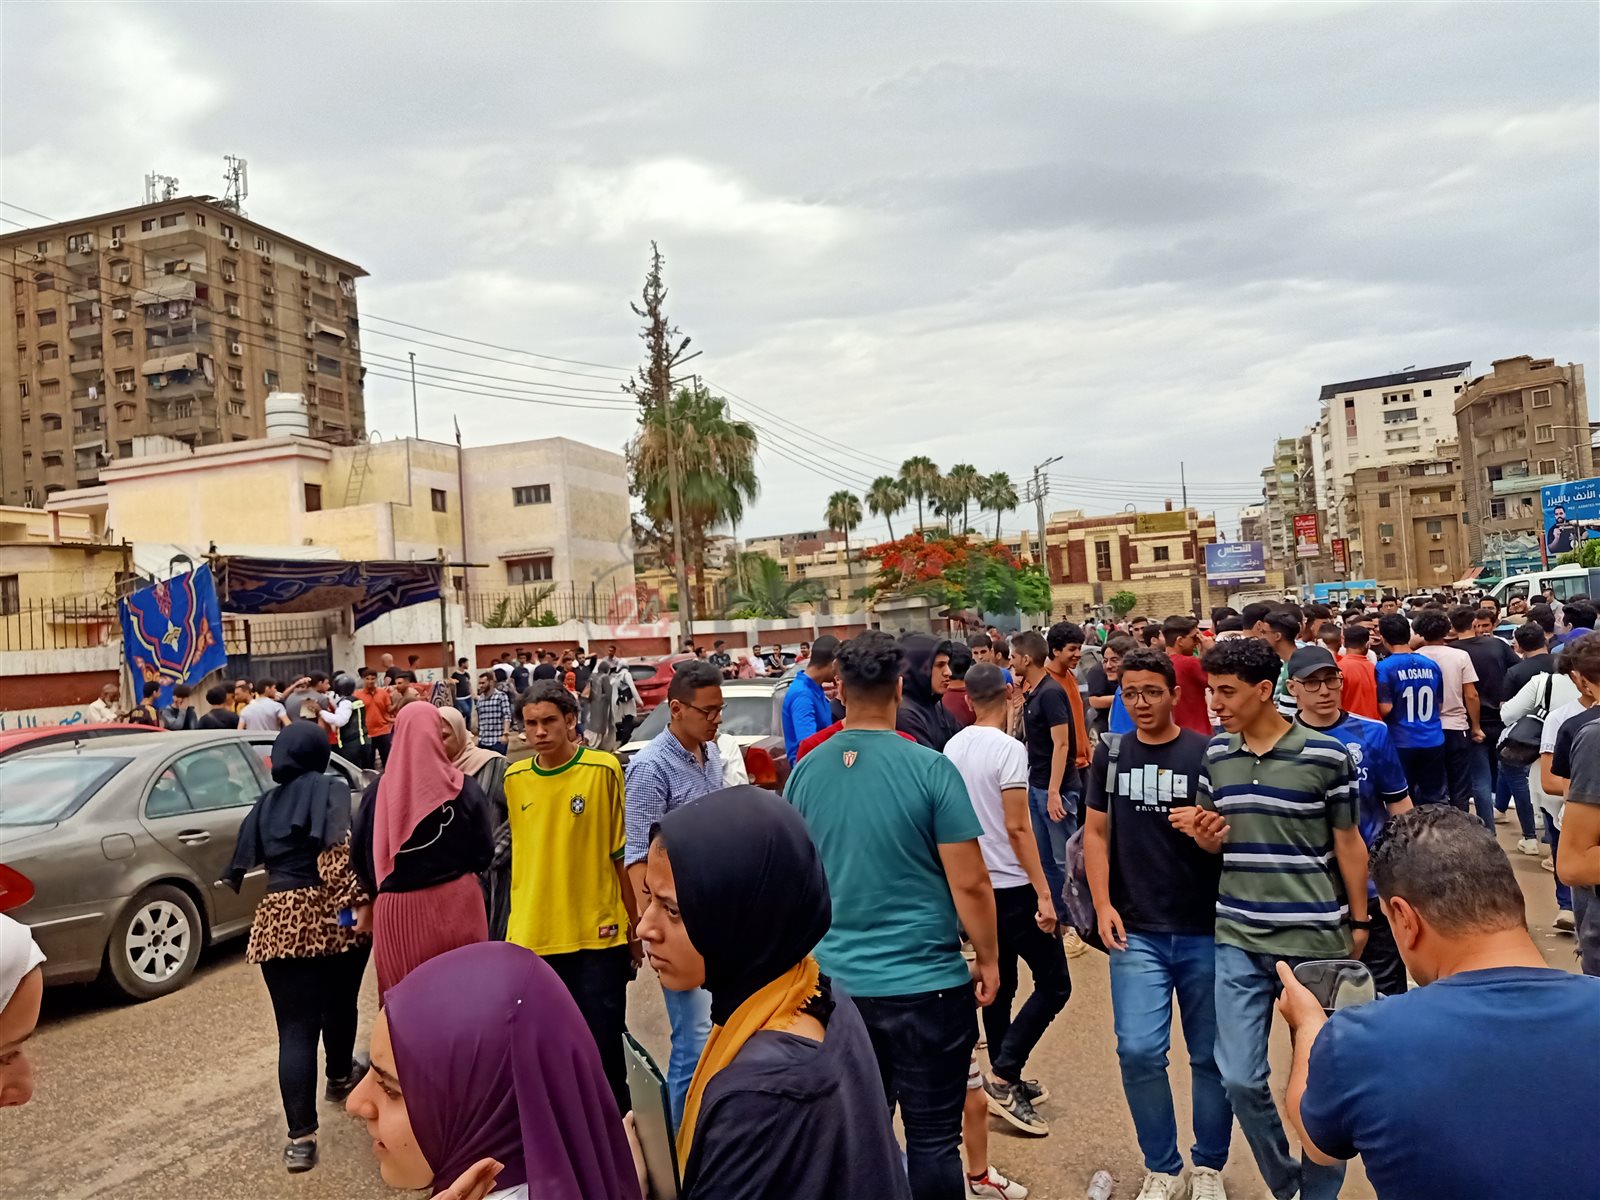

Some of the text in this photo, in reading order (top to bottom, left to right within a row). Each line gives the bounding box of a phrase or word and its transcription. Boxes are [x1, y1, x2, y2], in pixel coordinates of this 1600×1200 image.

[1547, 495, 1571, 507] بالليزر
[1573, 490, 1596, 501] الأنف
[1217, 543, 1251, 558] النحاس
[1402, 685, 1434, 723] 10
